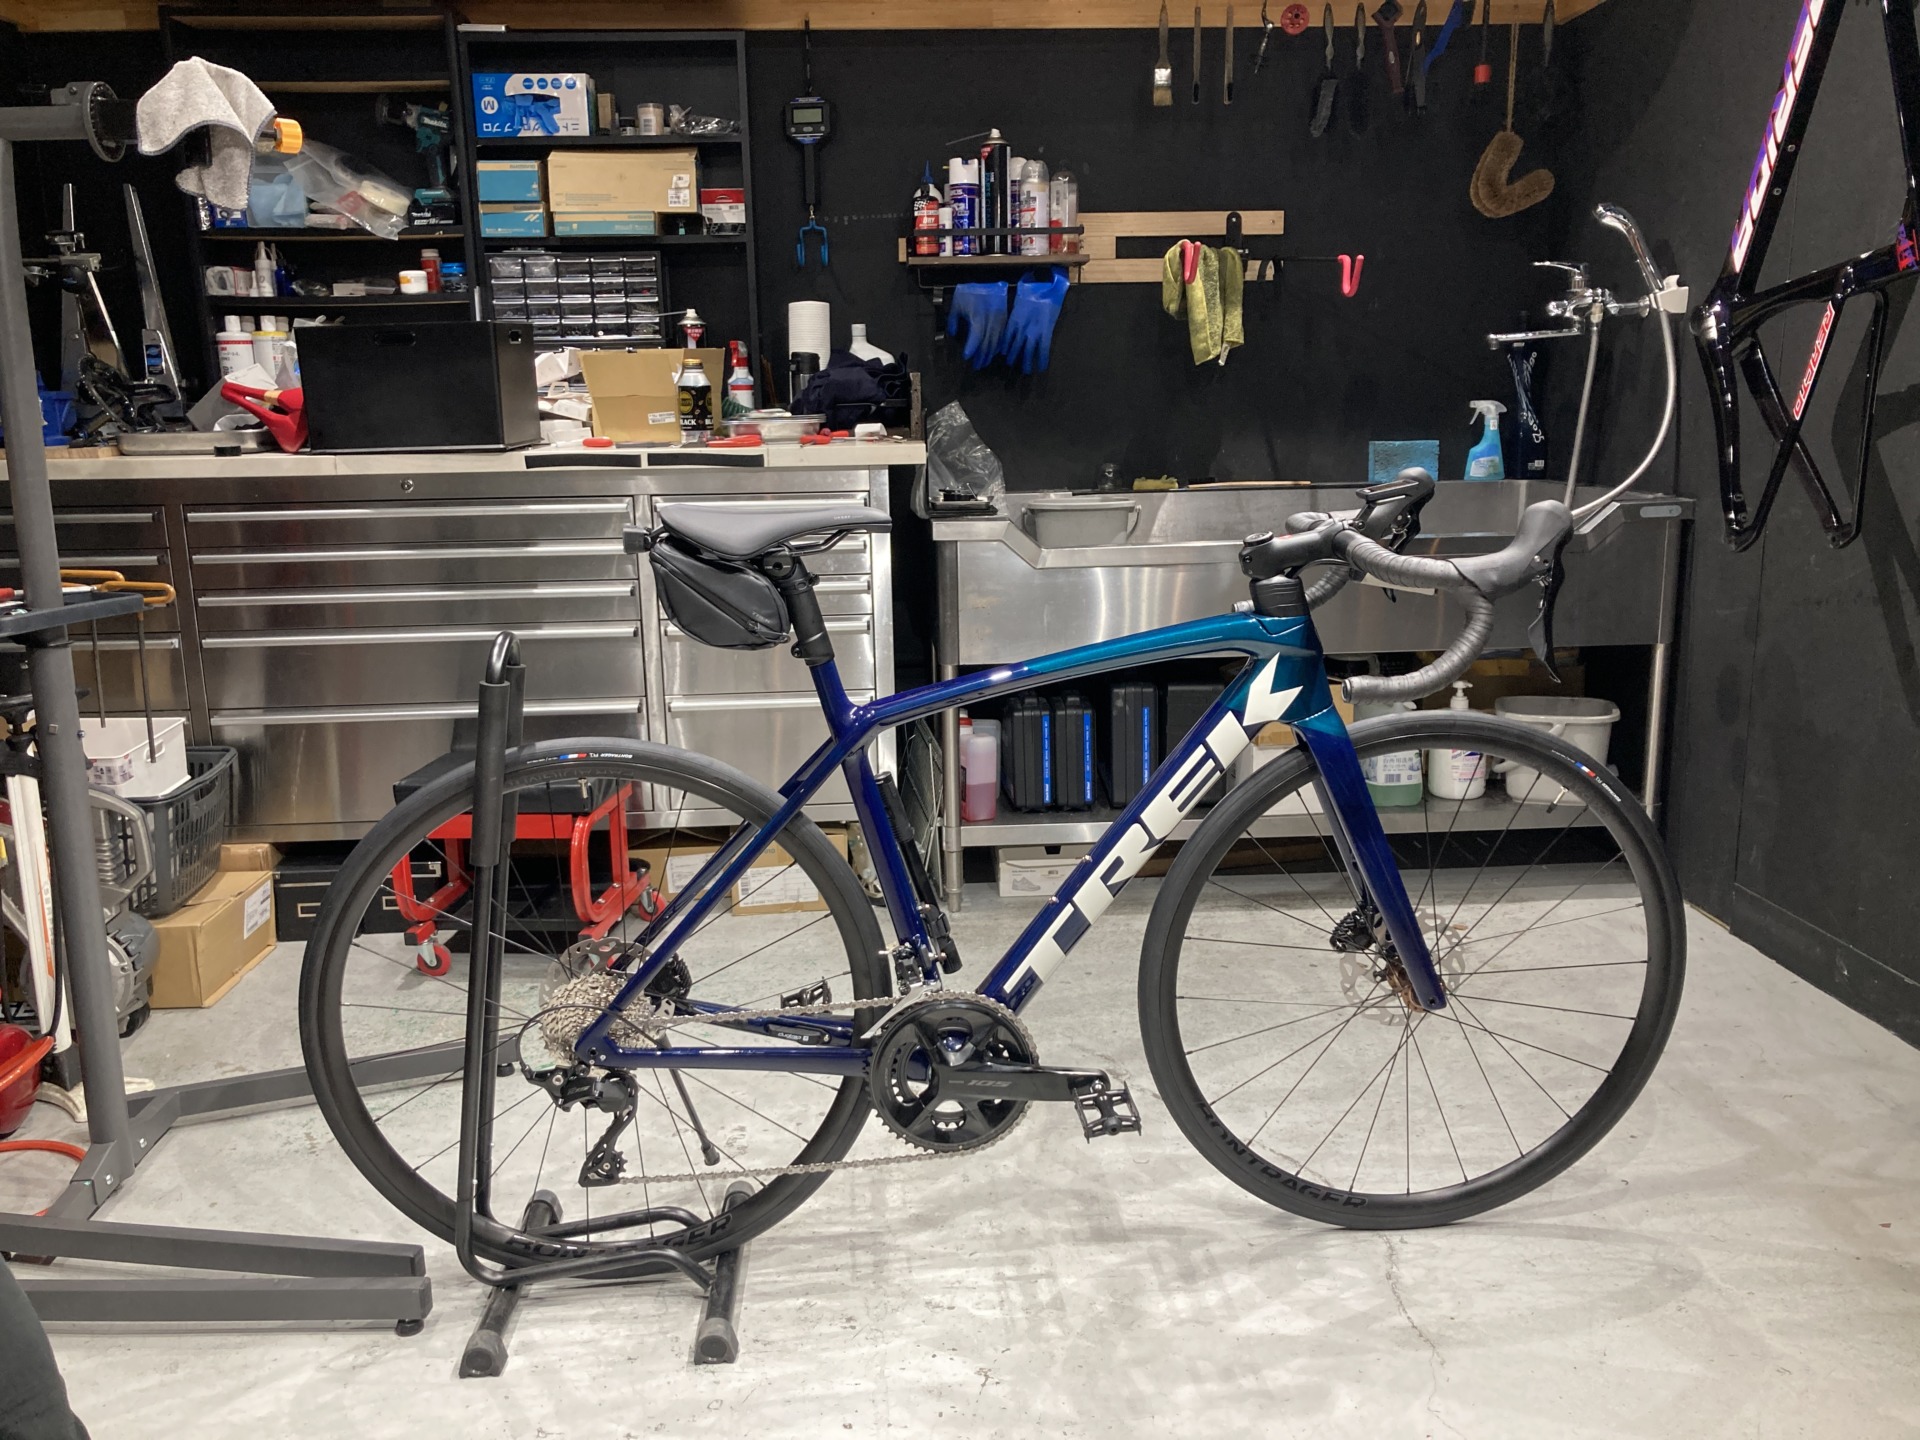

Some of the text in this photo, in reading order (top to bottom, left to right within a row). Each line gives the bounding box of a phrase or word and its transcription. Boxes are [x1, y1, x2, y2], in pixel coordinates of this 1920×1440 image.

[483, 100, 495, 111] M
[1793, 300, 1835, 420] REACTO
[1003, 652, 1303, 993] TREK
[1199, 1101, 1368, 1209] BONTRAGER
